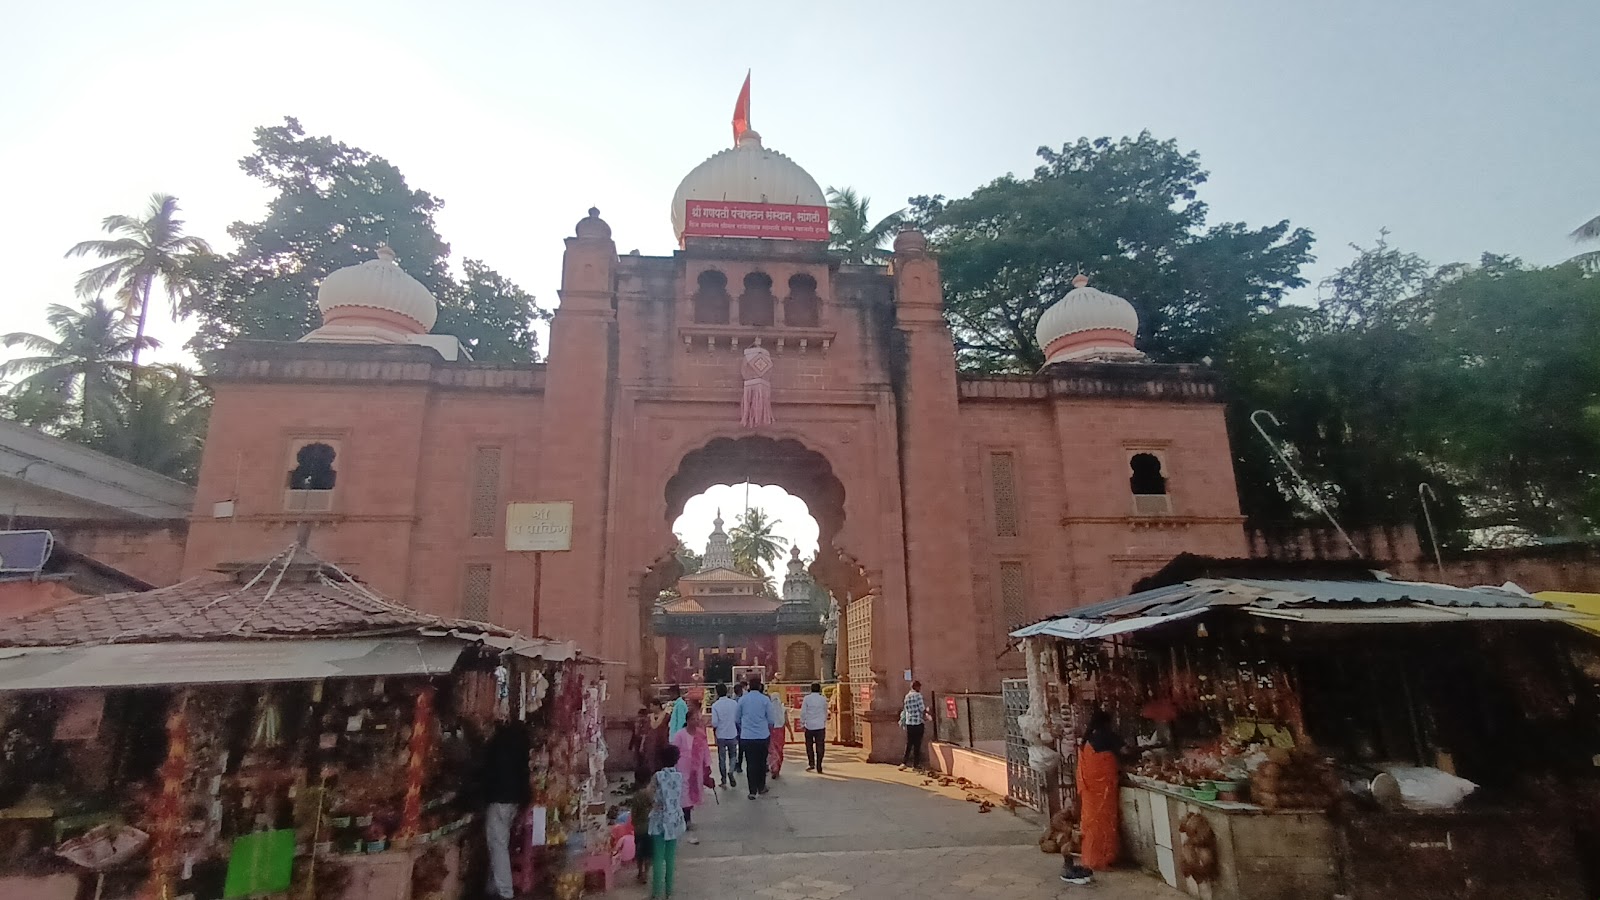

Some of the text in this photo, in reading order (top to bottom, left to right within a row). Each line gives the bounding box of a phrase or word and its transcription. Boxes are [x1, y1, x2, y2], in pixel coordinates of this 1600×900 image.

[692, 205, 823, 223] श्री गणपती पंचायतन संस्थान, सांगली.
